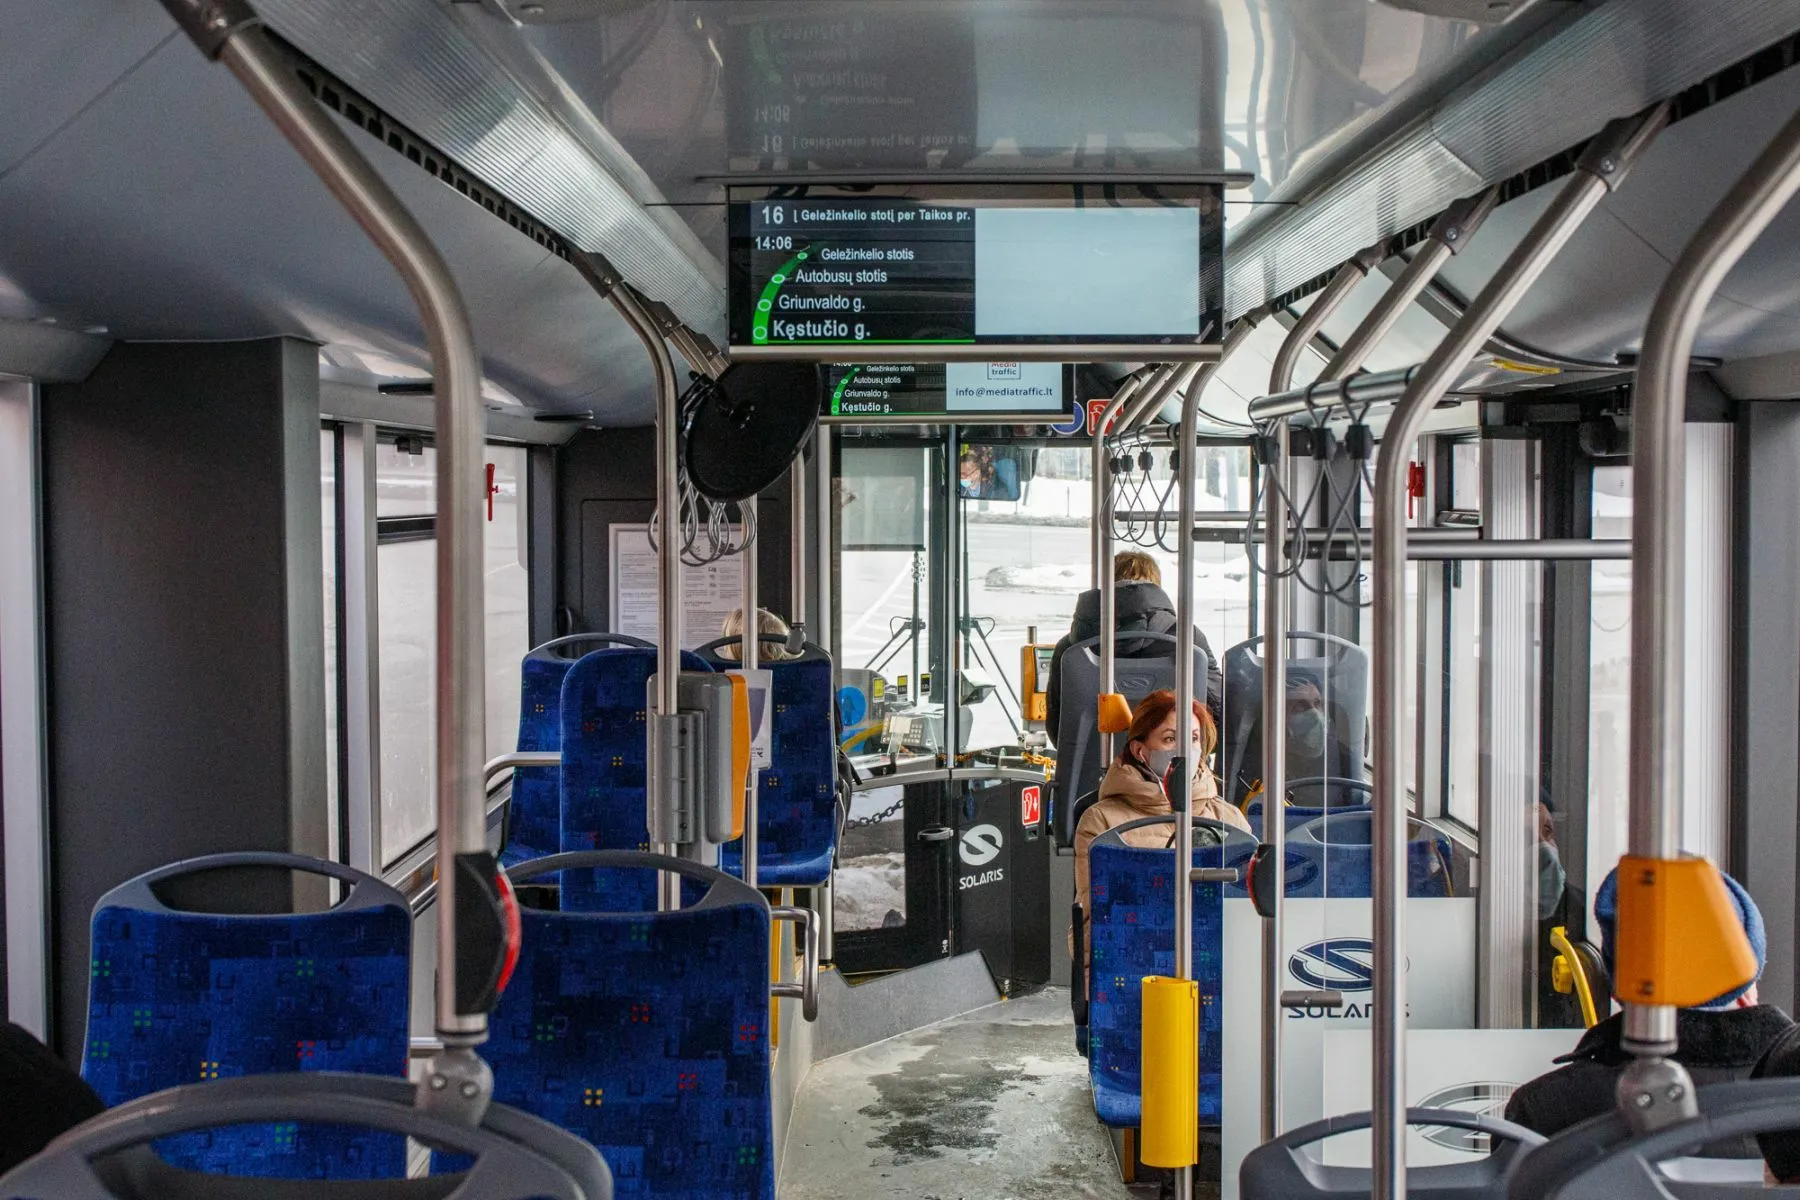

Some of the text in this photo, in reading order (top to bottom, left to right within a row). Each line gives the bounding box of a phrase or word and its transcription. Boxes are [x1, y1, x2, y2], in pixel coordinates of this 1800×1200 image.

[761, 206, 784, 224] 16
[801, 209, 867, 221] Geležinkelio
[870, 210, 895, 223] stotį
[898, 211, 915, 223] per
[918, 209, 953, 221] Taikos
[956, 211, 971, 223] pr.
[755, 236, 792, 250] 14:06
[821, 248, 915, 261] Geležinkelio stotis
[795, 269, 888, 286] Autobusų stotis
[778, 295, 866, 312] Griunvaldo g.
[773, 319, 871, 339] Kęstučio g.
[991, 368, 1017, 376] traffic
[884, 376, 902, 384] stotis
[955, 387, 1053, 397] info@mediatraffic.lt
[842, 402, 881, 413] Kęstučio
[959, 868, 1004, 890] SOLARIS
[1288, 1003, 1410, 1019] SOLA
